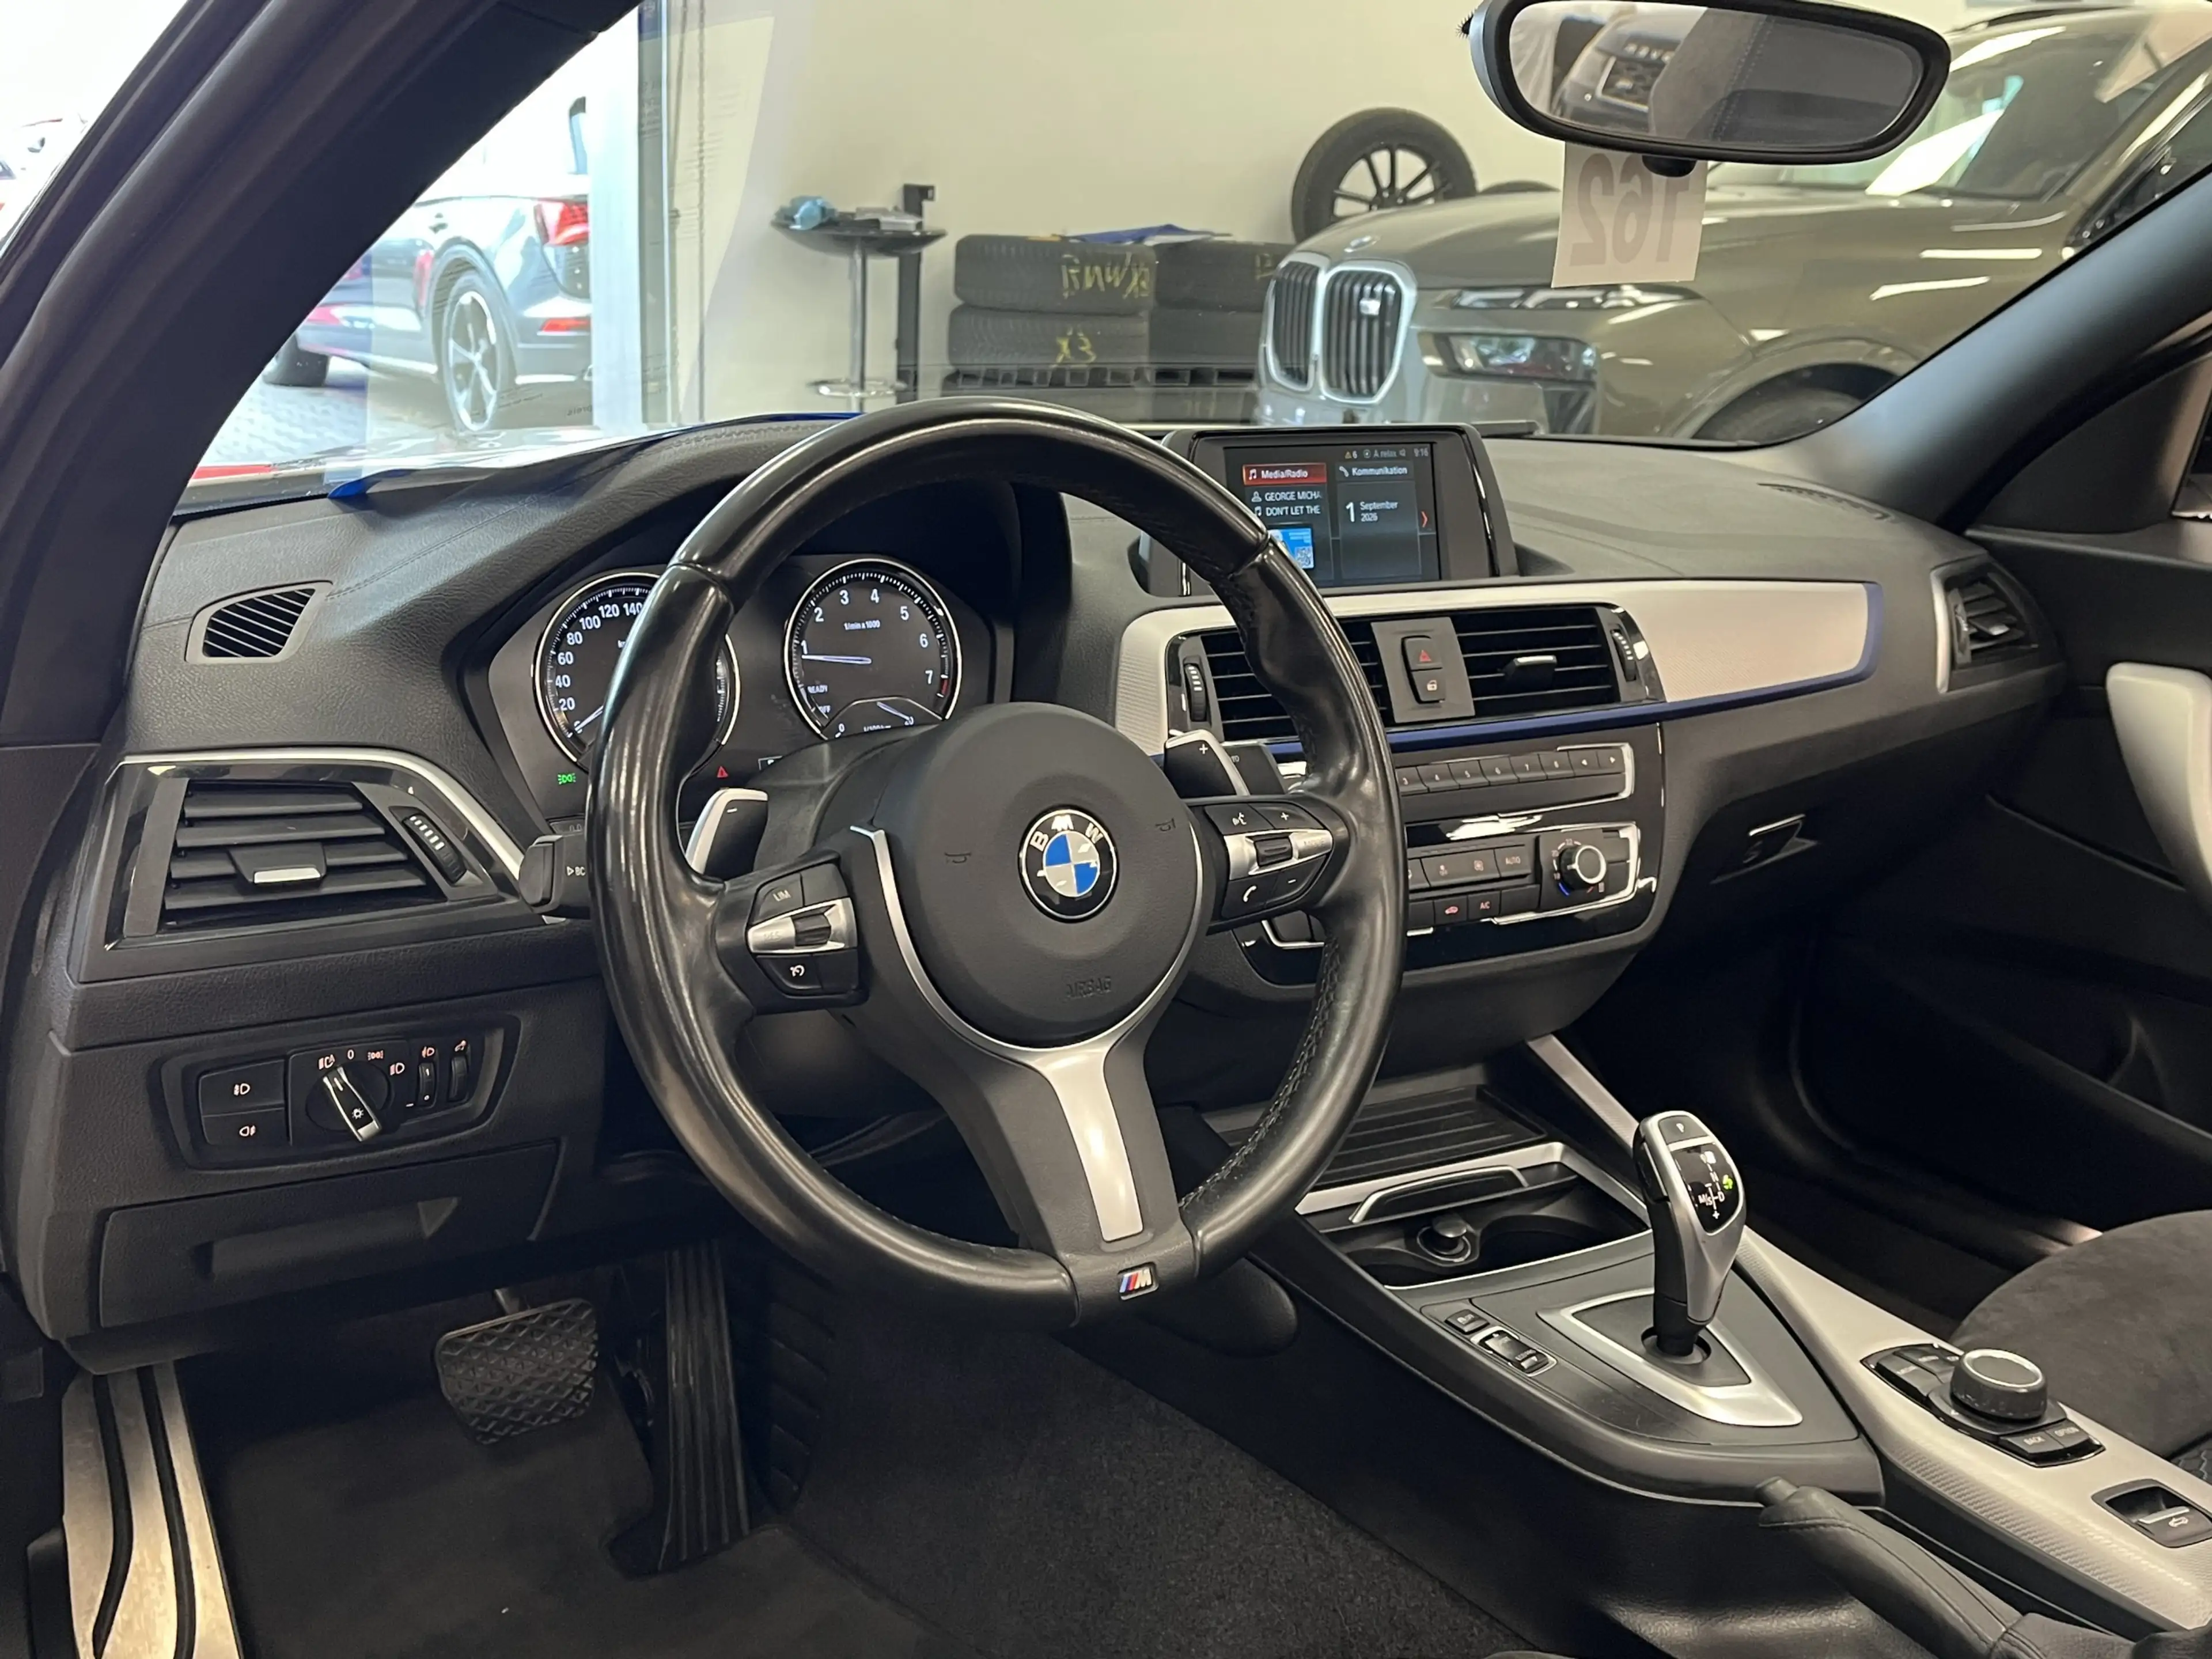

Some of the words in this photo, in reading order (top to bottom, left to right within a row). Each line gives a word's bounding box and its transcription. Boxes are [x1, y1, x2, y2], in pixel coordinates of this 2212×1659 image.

[1261, 469, 1308, 479] Media/Radio
[1352, 466, 1407, 476] Kommunikation
[1264, 492, 1296, 501] GEORGE
[1266, 506, 1289, 516] DON'T
[1290, 506, 1304, 516] LET
[1305, 505, 1321, 514] THE
[1360, 501, 1398, 512] September
[839, 589, 849, 605] 3
[870, 588, 880, 603] 4
[599, 604, 620, 618] 120
[814, 607, 824, 622] 2
[900, 606, 909, 620] 5
[579, 615, 601, 630] 100
[865, 620, 881, 628] 1000
[567, 631, 583, 646] 80
[919, 633, 929, 648] 6
[801, 639, 808, 654] 1
[557, 651, 574, 665] 60
[555, 675, 571, 688] 40
[925, 669, 933, 684] 7
[559, 697, 575, 711] 20
[839, 723, 844, 733] 0
[1402, 777, 1408, 785] 3
[1029, 814, 1104, 852] BMW
[1505, 855, 1521, 865] AUTO
[772, 889, 791, 902] LIM
[1479, 900, 1491, 910] A/C
[347, 1050, 354, 1060] 0
[1717, 1191, 1725, 1203] D
[2023, 1436, 2046, 1445] BACK
